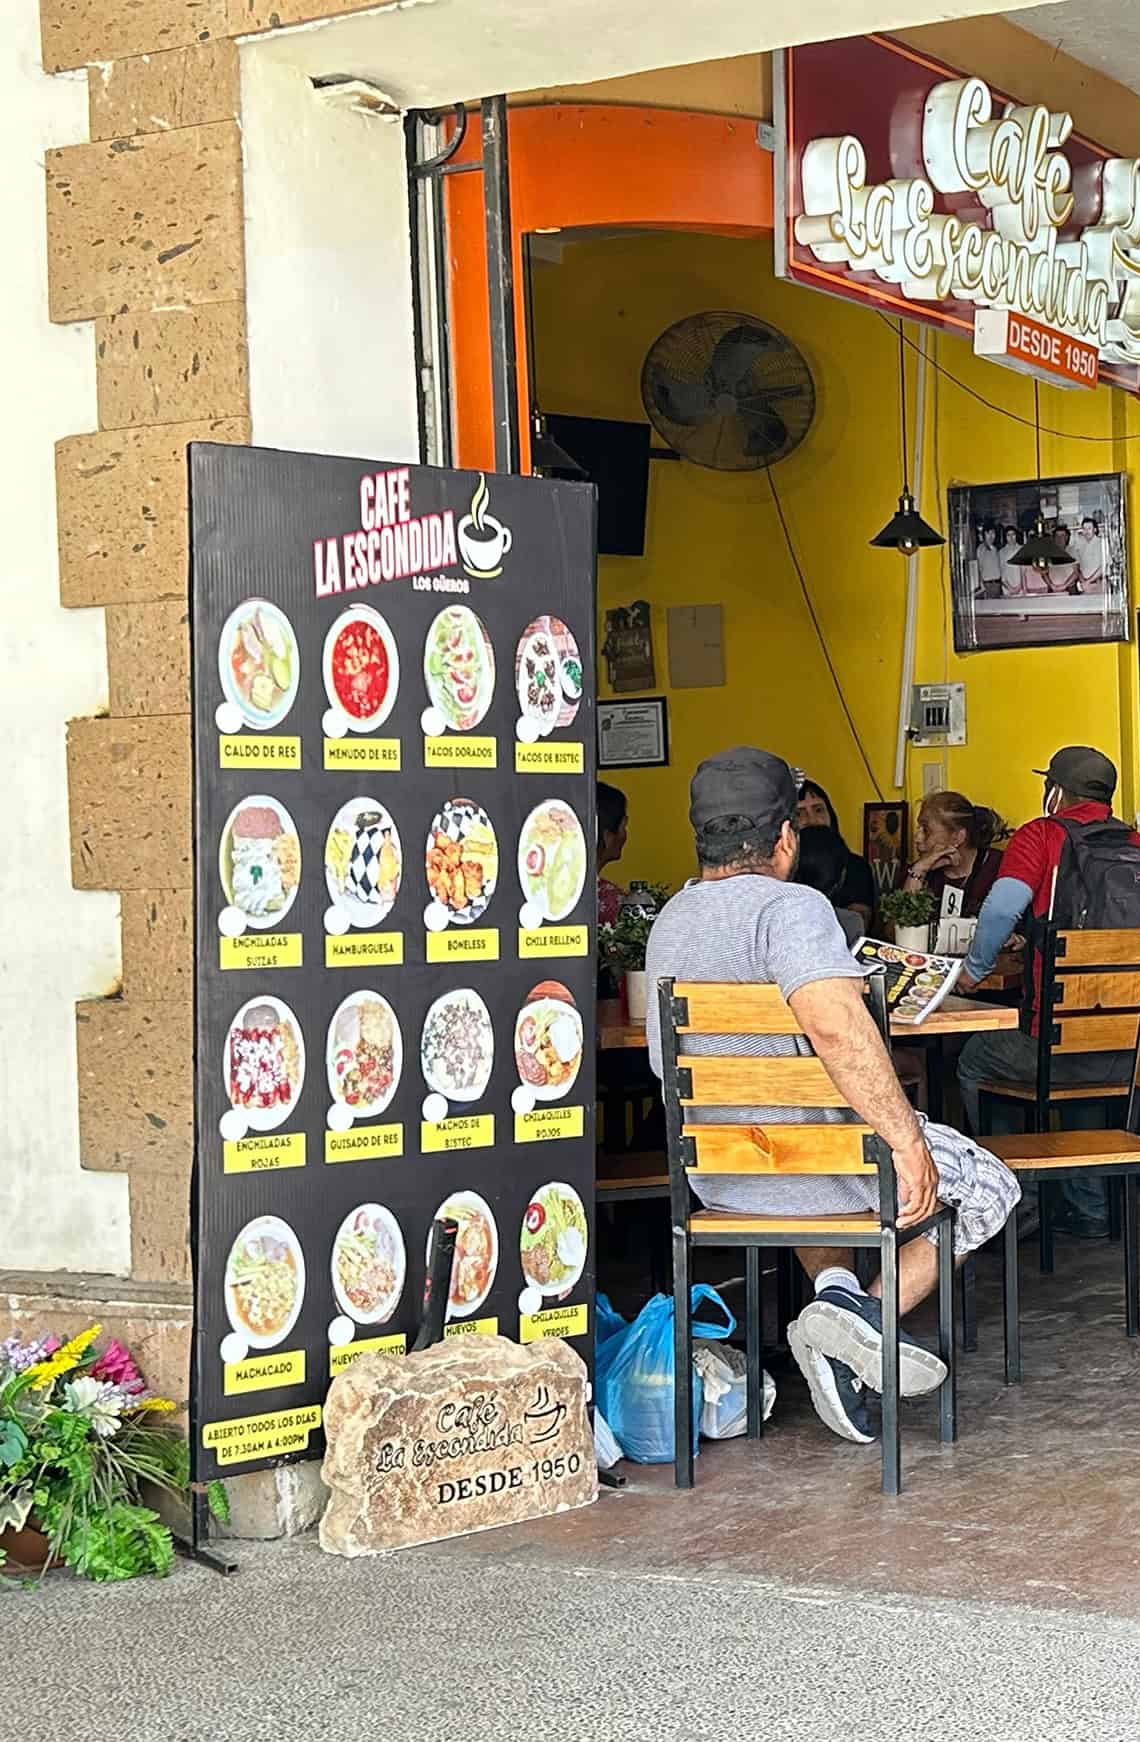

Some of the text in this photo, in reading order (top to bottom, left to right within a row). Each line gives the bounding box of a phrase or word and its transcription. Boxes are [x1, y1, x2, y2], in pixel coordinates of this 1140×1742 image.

[928, 77, 1073, 241] Café
[806, 135, 1112, 346] La Escondida
[1009, 320, 1097, 380] DESDE 1950
[359, 468, 410, 530] CAFE
[313, 510, 457, 598] LA ESCONDIDA
[412, 576, 431, 591] LOS
[224, 744, 296, 758] CALDO DE RES
[328, 748, 397, 760] MENUDO DE RES
[427, 746, 492, 758] TACOS DORADOS
[517, 752, 580, 764] TACOS DE BISTEC
[232, 936, 289, 949] ENCHILADAS
[447, 939, 486, 951] BONELESS
[526, 935, 581, 947] CHILE RELLENO
[332, 943, 395, 956] HAMBURGUESA
[246, 956, 278, 967] SUIZAS
[523, 1109, 572, 1123] CHILAQUILES
[436, 1118, 480, 1132] NACHOS DE
[536, 1128, 561, 1138] ROJOS
[236, 1137, 292, 1152] ENCHILADAS
[330, 1133, 398, 1150] GUISADO DE RES
[444, 1137, 472, 1148] BISTEC
[251, 1157, 280, 1168] ROJAS
[531, 1307, 579, 1324] CHILAQUILES
[446, 1321, 477, 1337] HUEVOS
[235, 1361, 293, 1381] MACHACADO
[436, 1391, 498, 1436] Café
[207, 1411, 317, 1441] ABIERTO TODOS LOS DIAS
[221, 1446, 232, 1458] DE
[266, 1440, 273, 1449] A
[376, 1421, 524, 1473] La Escondida
[437, 1454, 581, 1504] DESDE 1950
